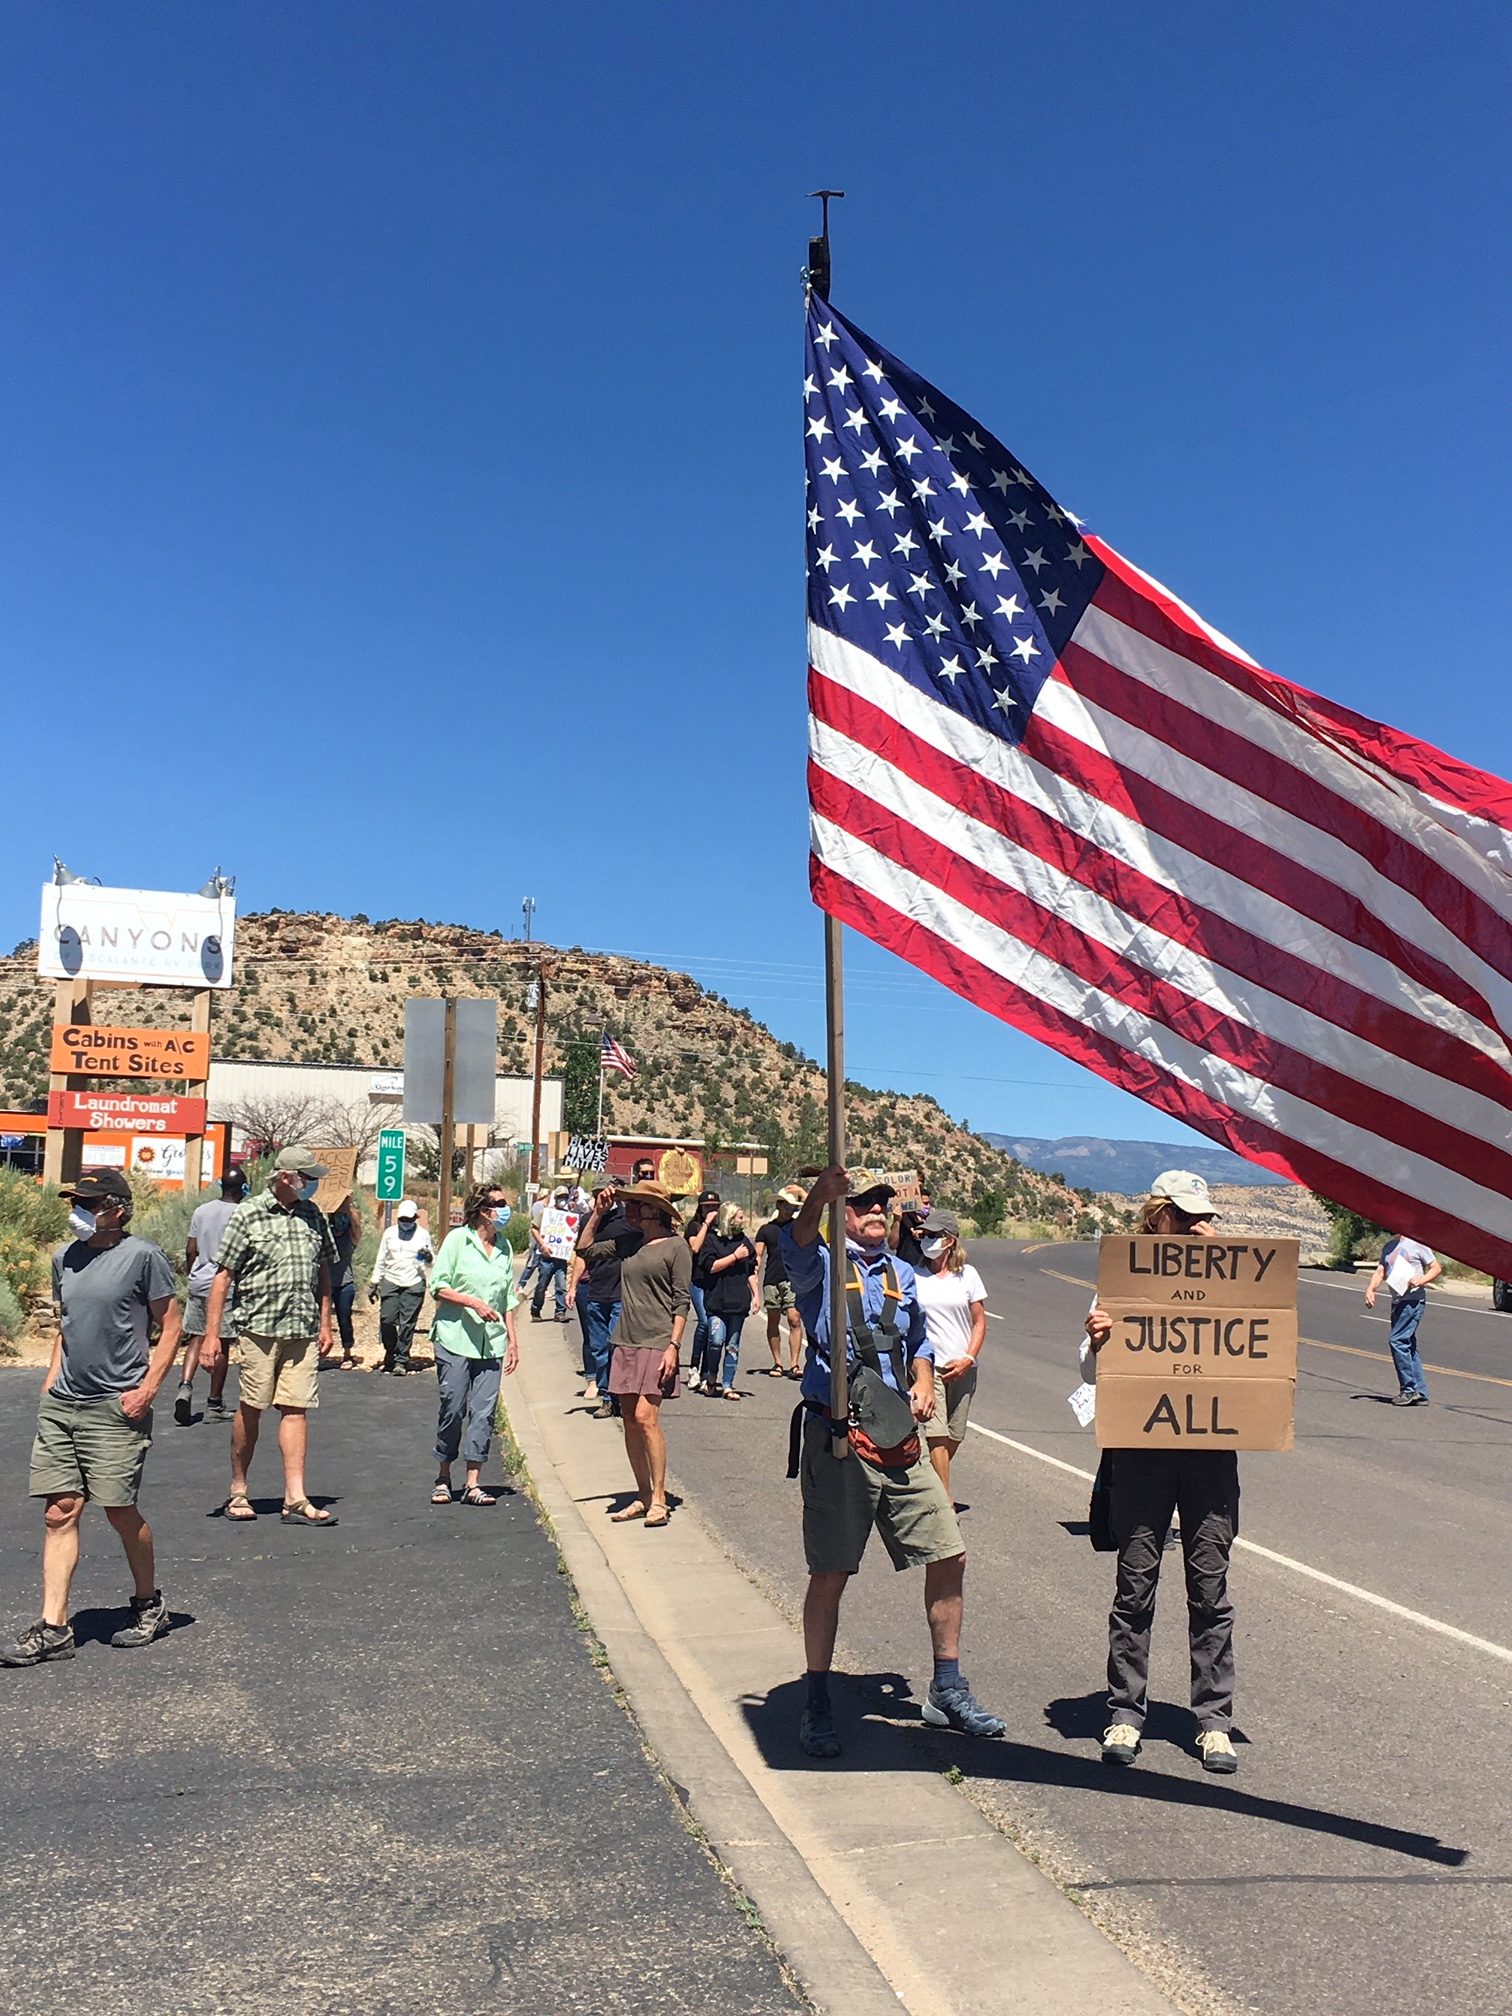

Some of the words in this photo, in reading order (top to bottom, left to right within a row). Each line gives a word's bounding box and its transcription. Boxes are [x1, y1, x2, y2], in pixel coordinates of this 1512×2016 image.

[53, 923, 222, 954] CANYONS
[63, 1028, 138, 1050] Cabins
[143, 1040, 163, 1048] with
[71, 1050, 120, 1070] Tent
[128, 1053, 184, 1075] Sites
[74, 1093, 178, 1114] Laundromat
[89, 1111, 167, 1131] Showers
[381, 1136, 403, 1149] MILE
[570, 1136, 612, 1153] BLACK
[564, 1155, 606, 1172] MATTER
[567, 1146, 609, 1162] LIVES
[914, 1187, 920, 1196] A
[1129, 1241, 1277, 1282] LIBERTY
[1171, 1289, 1206, 1301] AND
[1123, 1316, 1269, 1359] JUSTICE
[1172, 1363, 1203, 1375] FOR
[1142, 1393, 1239, 1436] ALL
